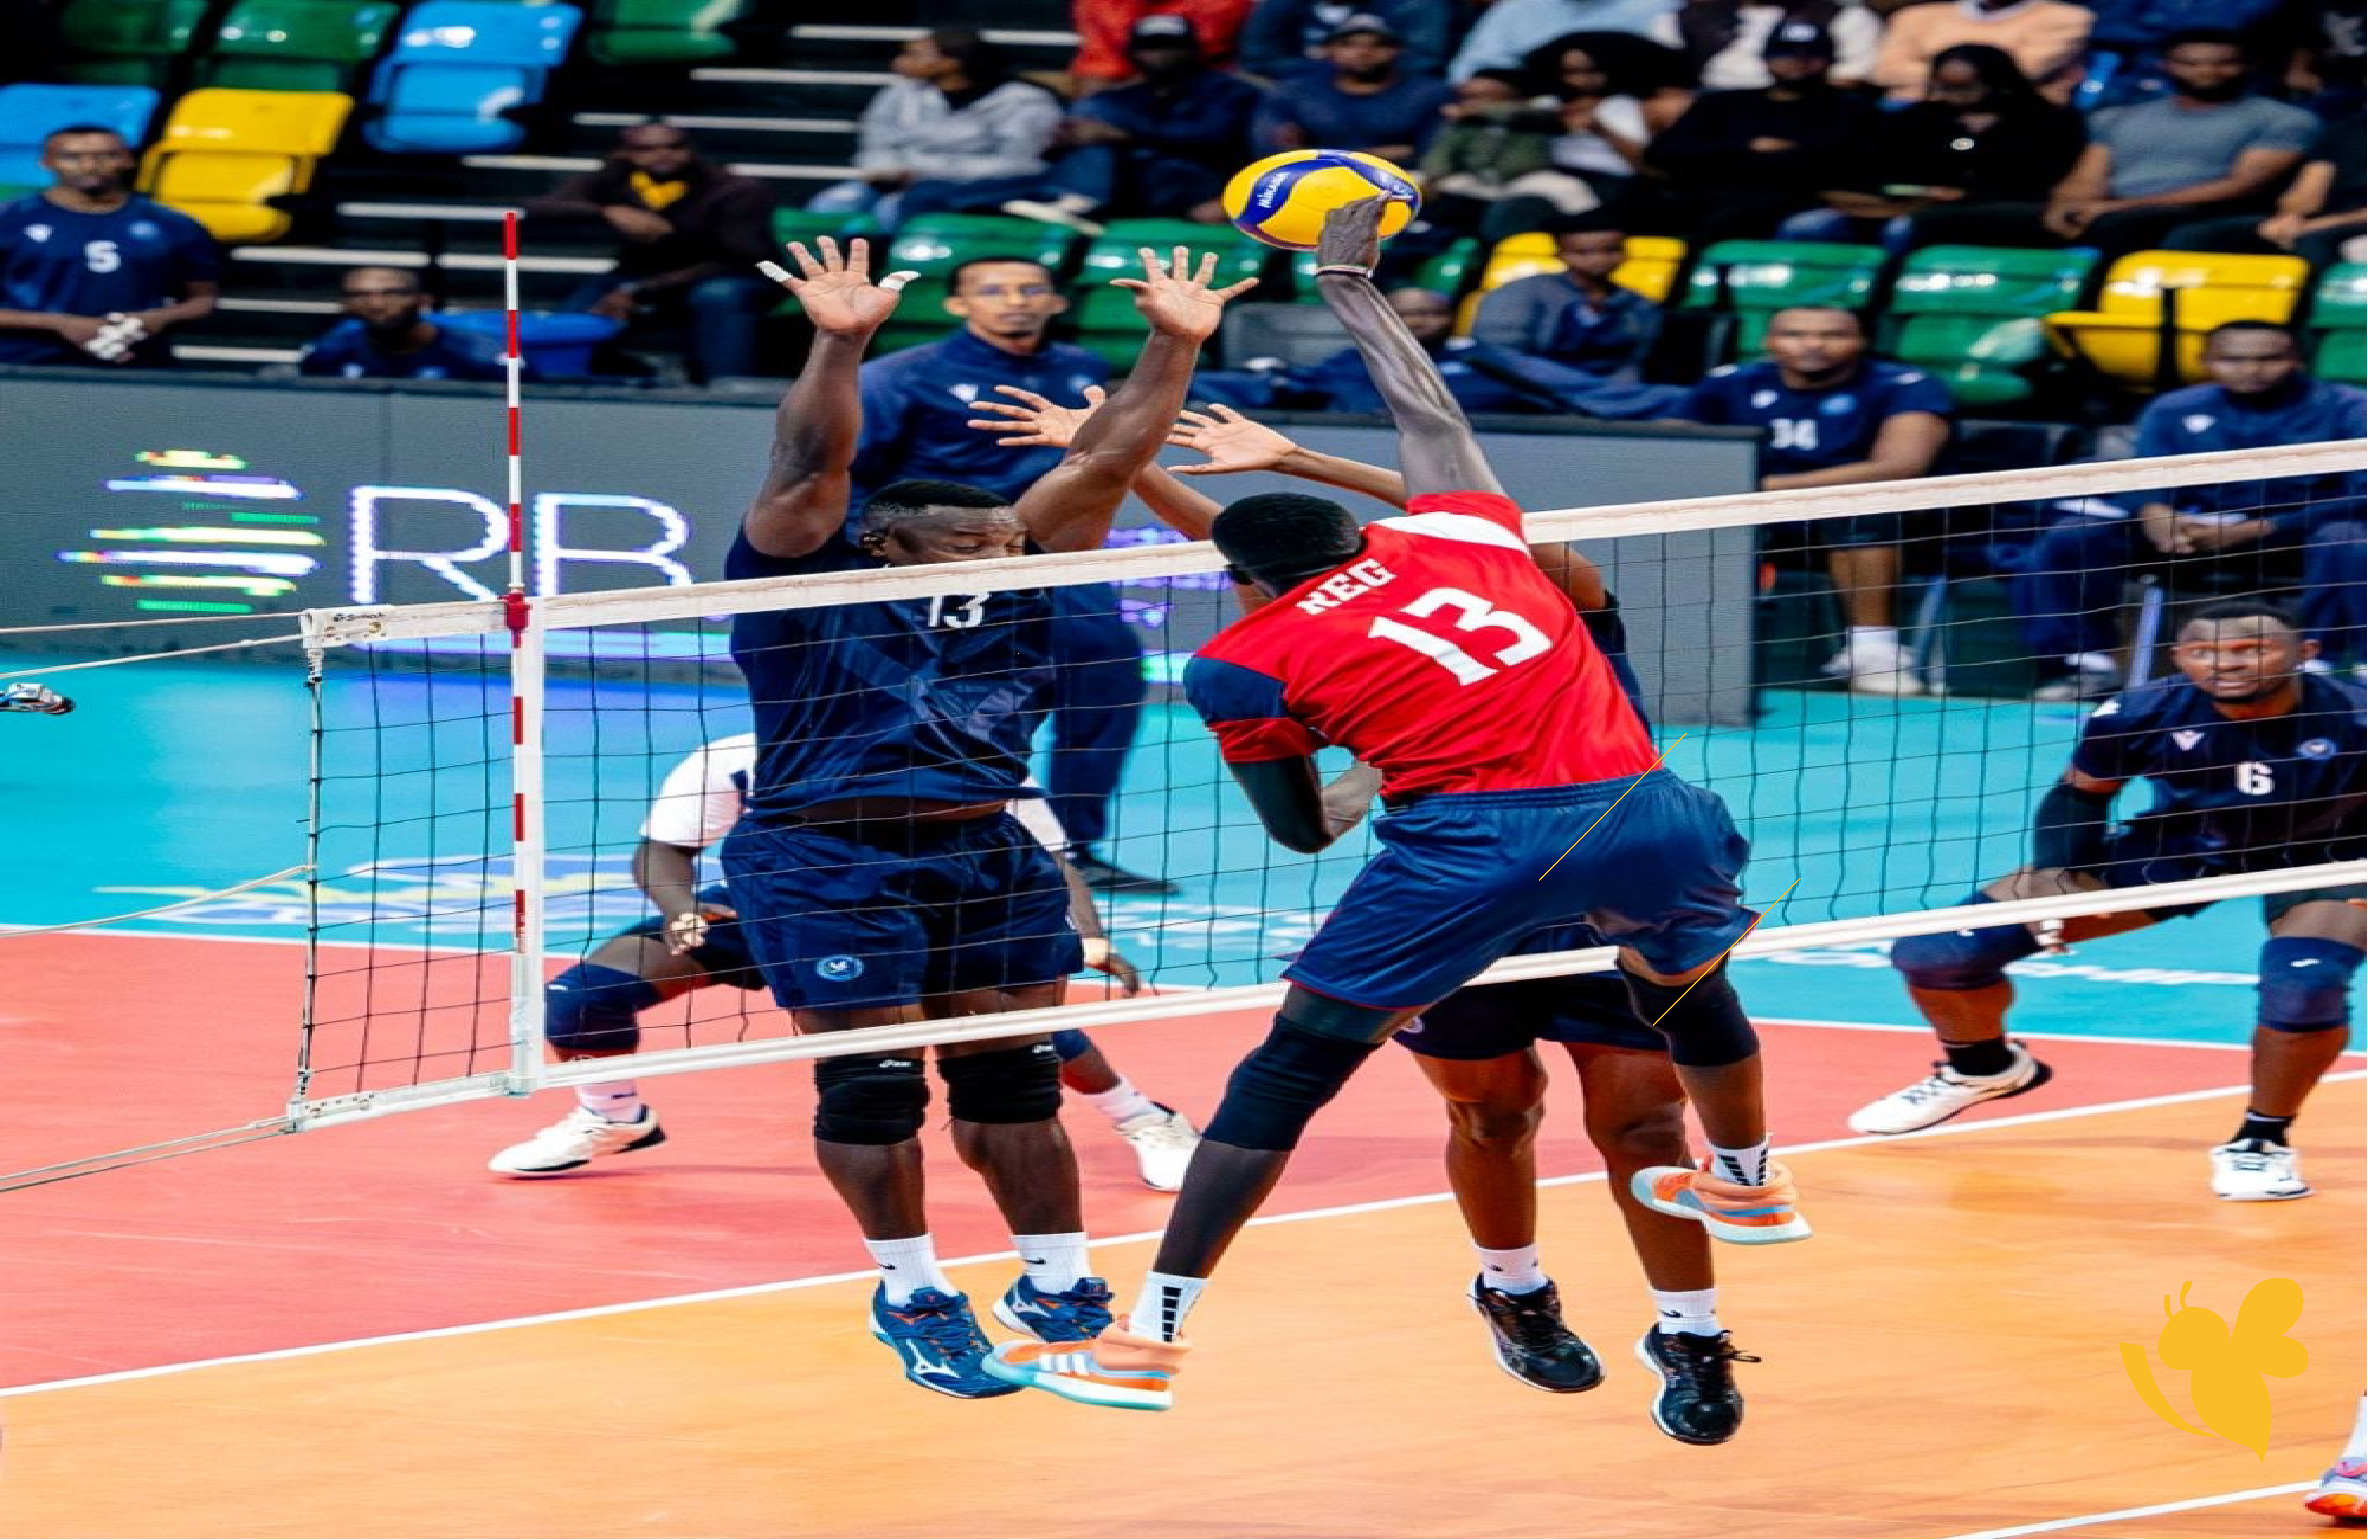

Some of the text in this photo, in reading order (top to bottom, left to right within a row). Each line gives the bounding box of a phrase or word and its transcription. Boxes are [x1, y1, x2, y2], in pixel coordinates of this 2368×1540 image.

[928, 591, 989, 628] 13
[1296, 558, 1397, 616] NEG
[1367, 587, 1552, 686] 13
[2236, 761, 2275, 796] 6
